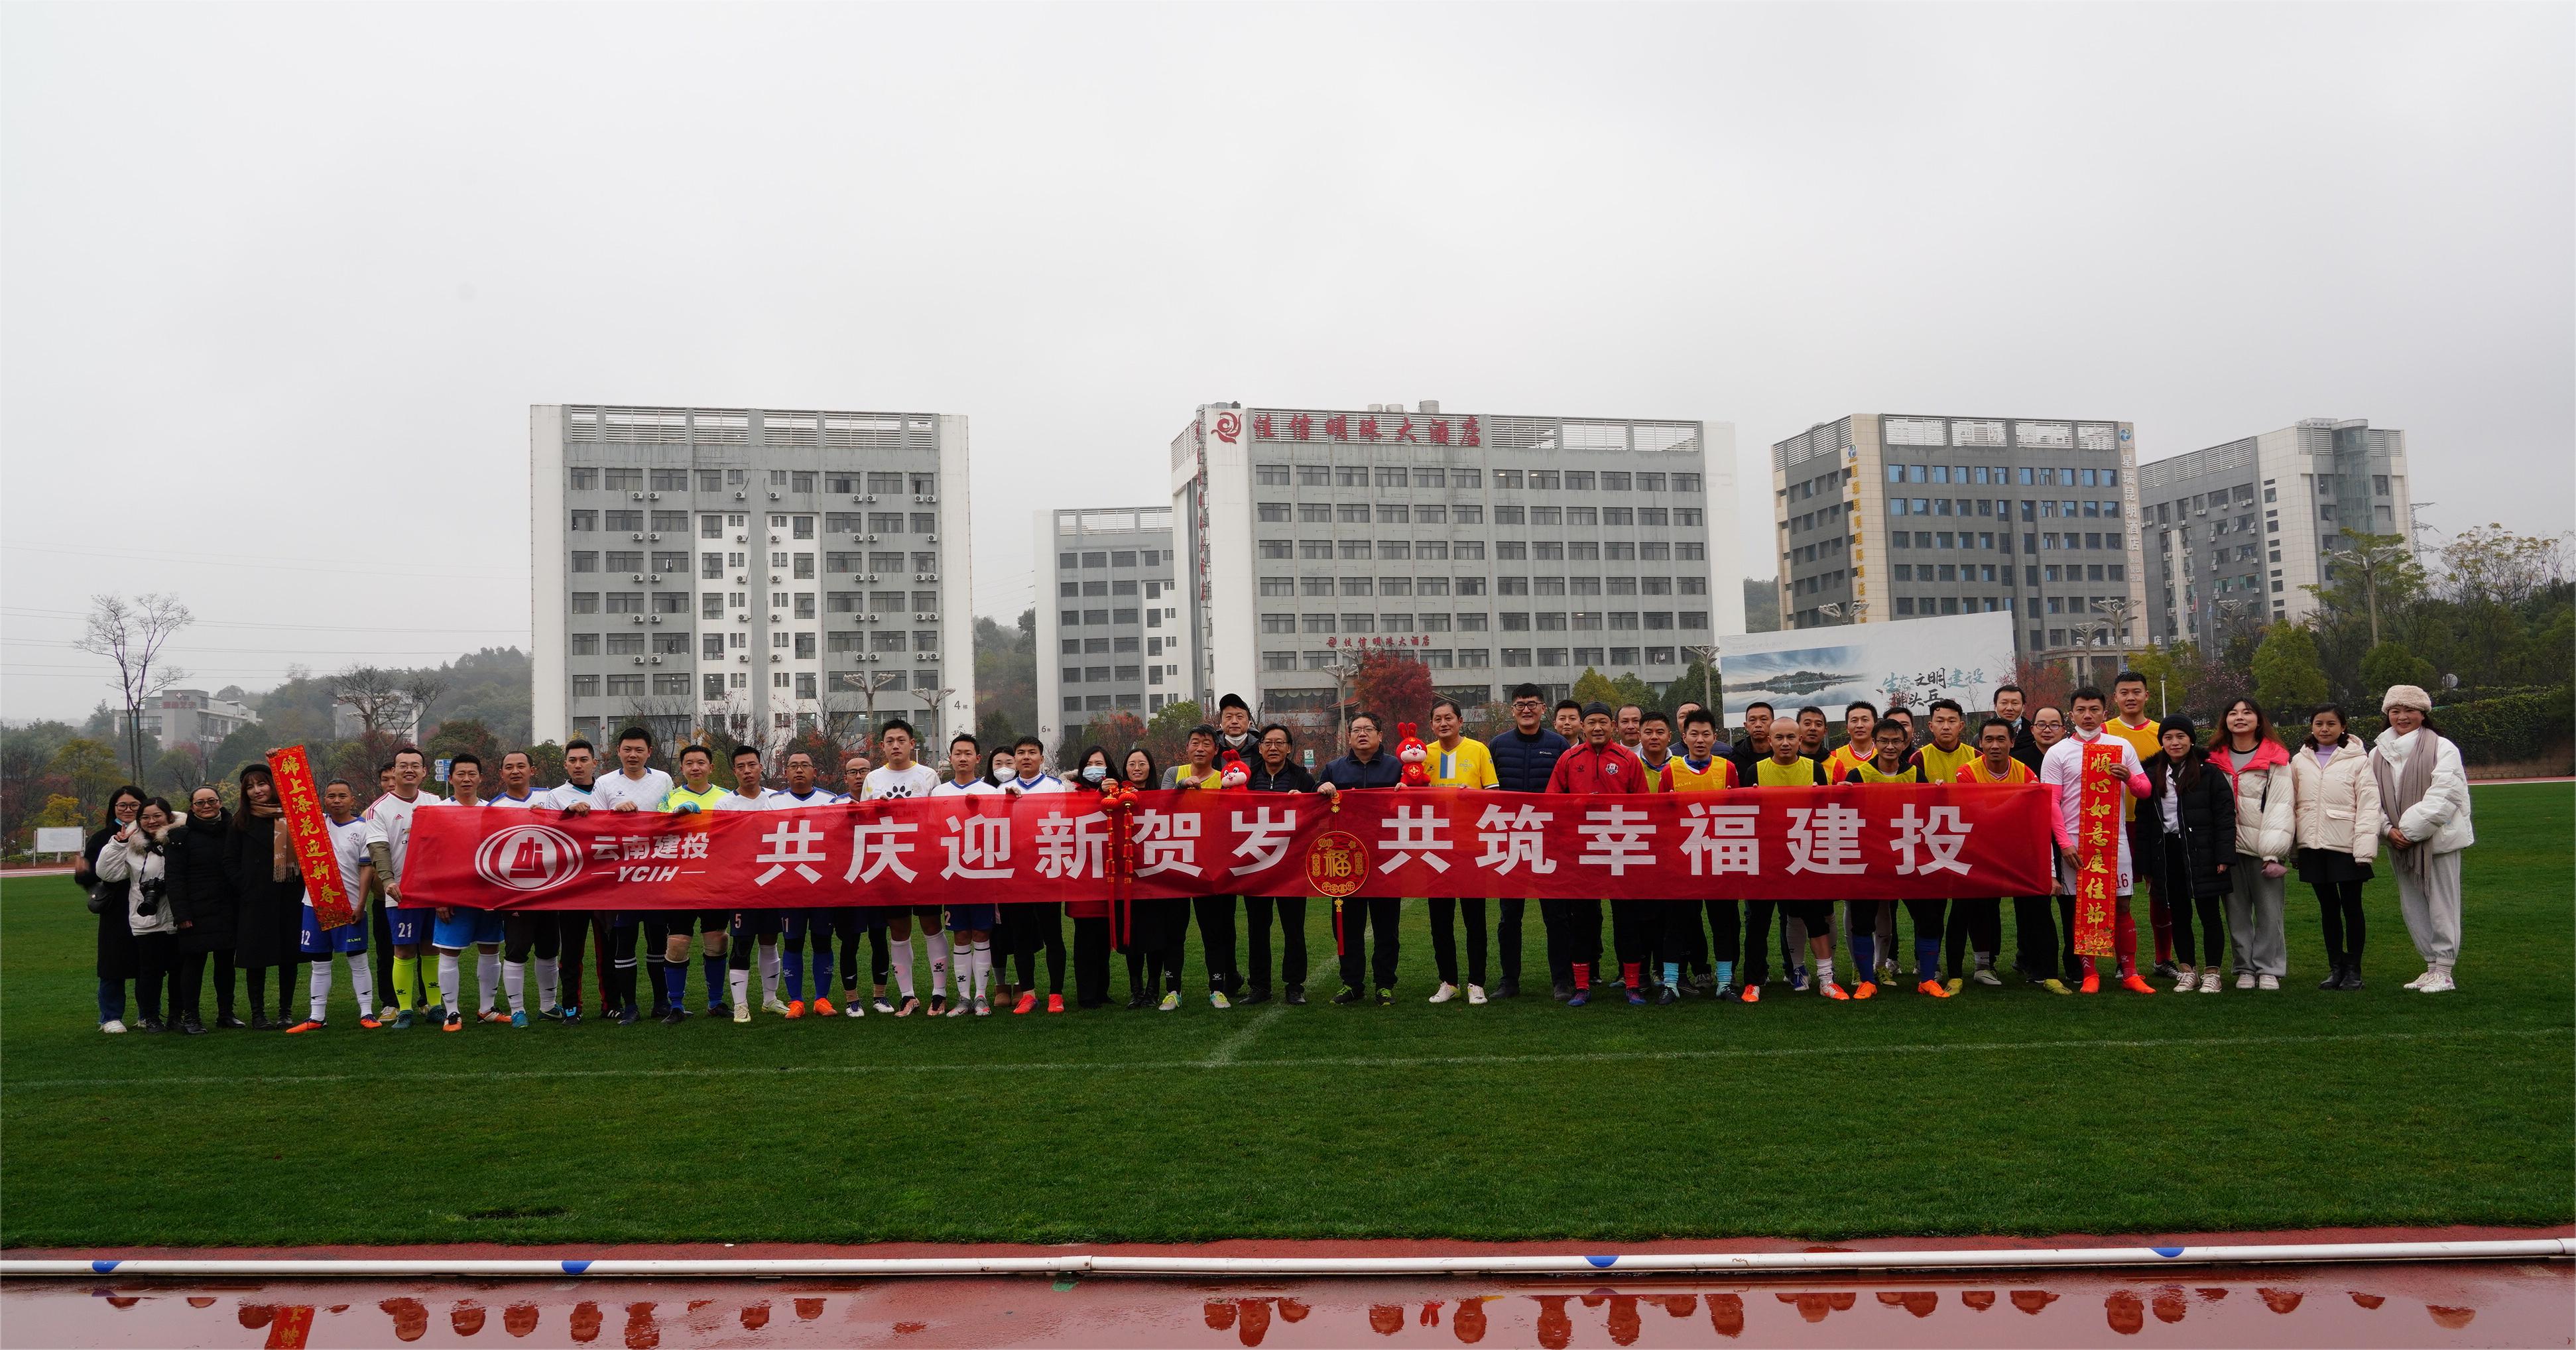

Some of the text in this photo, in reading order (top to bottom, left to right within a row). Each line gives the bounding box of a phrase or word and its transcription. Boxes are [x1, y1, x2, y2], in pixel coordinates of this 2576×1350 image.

[1253, 413, 1481, 446] 佳信明珠大酒店
[2122, 455, 2140, 552] 星瑞昆明酒店
[1344, 635, 1430, 648] 佳信明珠大酒店
[1882, 667, 1987, 694] 生态文明建设
[591, 831, 710, 861] 云南建投
[753, 802, 1975, 887] 共庆迎新贺岁 共筑幸福建投
[617, 865, 680, 883] YCIH
[1323, 849, 1352, 878] 福
[398, 922, 412, 938] 21
[735, 913, 742, 929] 5
[300, 929, 311, 946] 12
